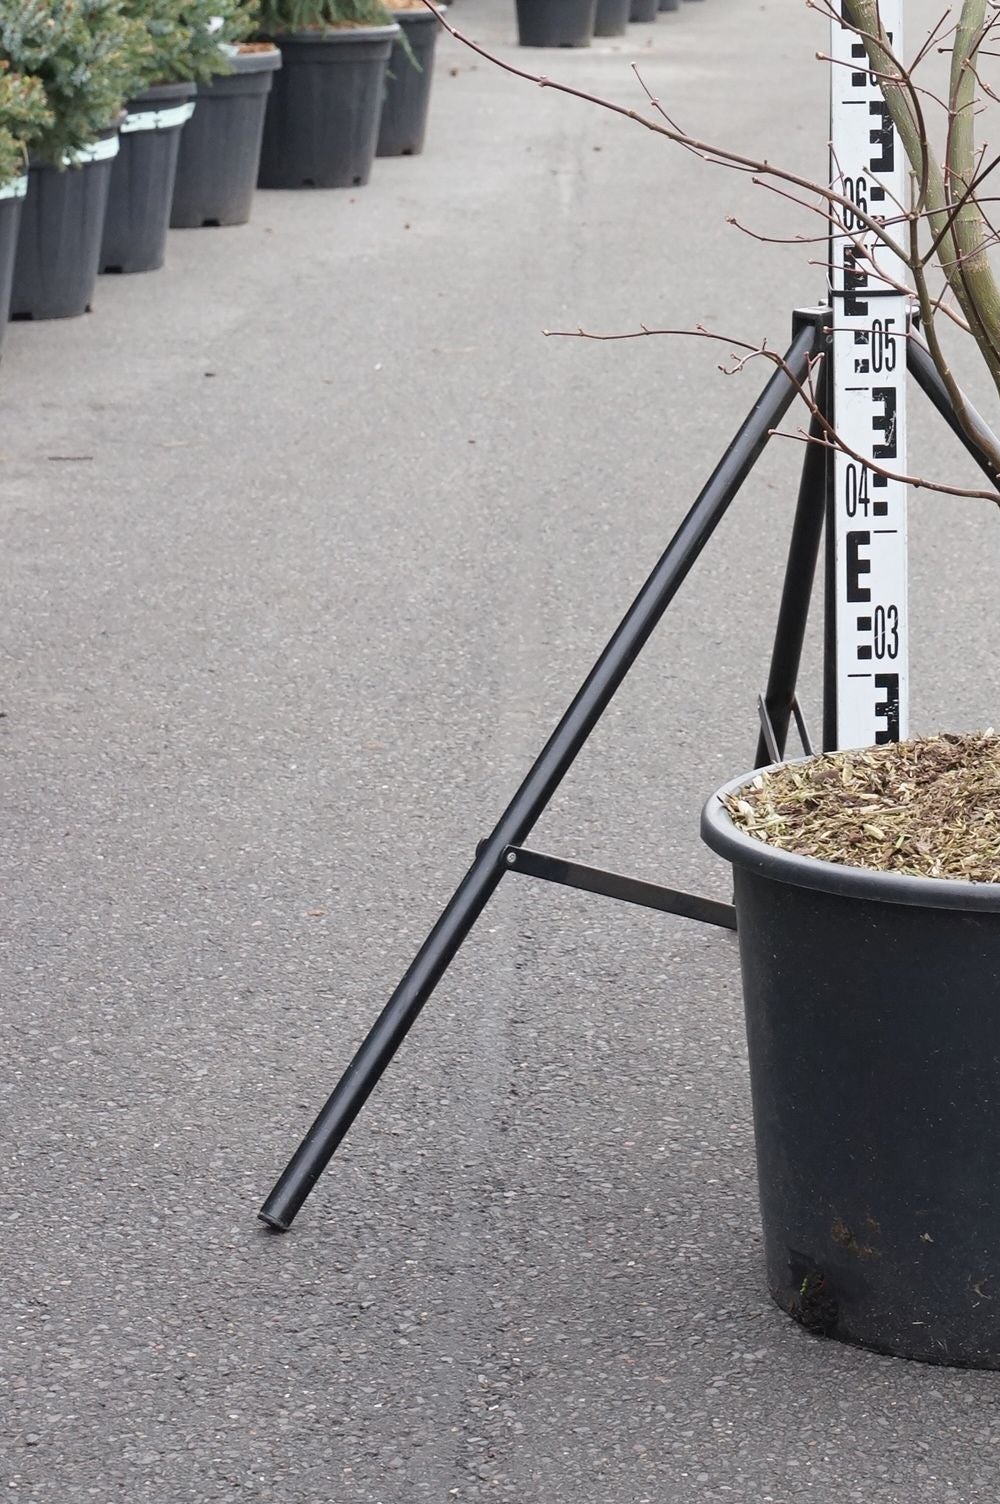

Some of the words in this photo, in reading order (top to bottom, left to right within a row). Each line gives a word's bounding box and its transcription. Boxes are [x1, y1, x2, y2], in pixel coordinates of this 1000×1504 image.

[843, 176, 869, 231] 06
[871, 318, 897, 373] 05
[845, 463, 870, 518] 04
[874, 604, 899, 660] 03
